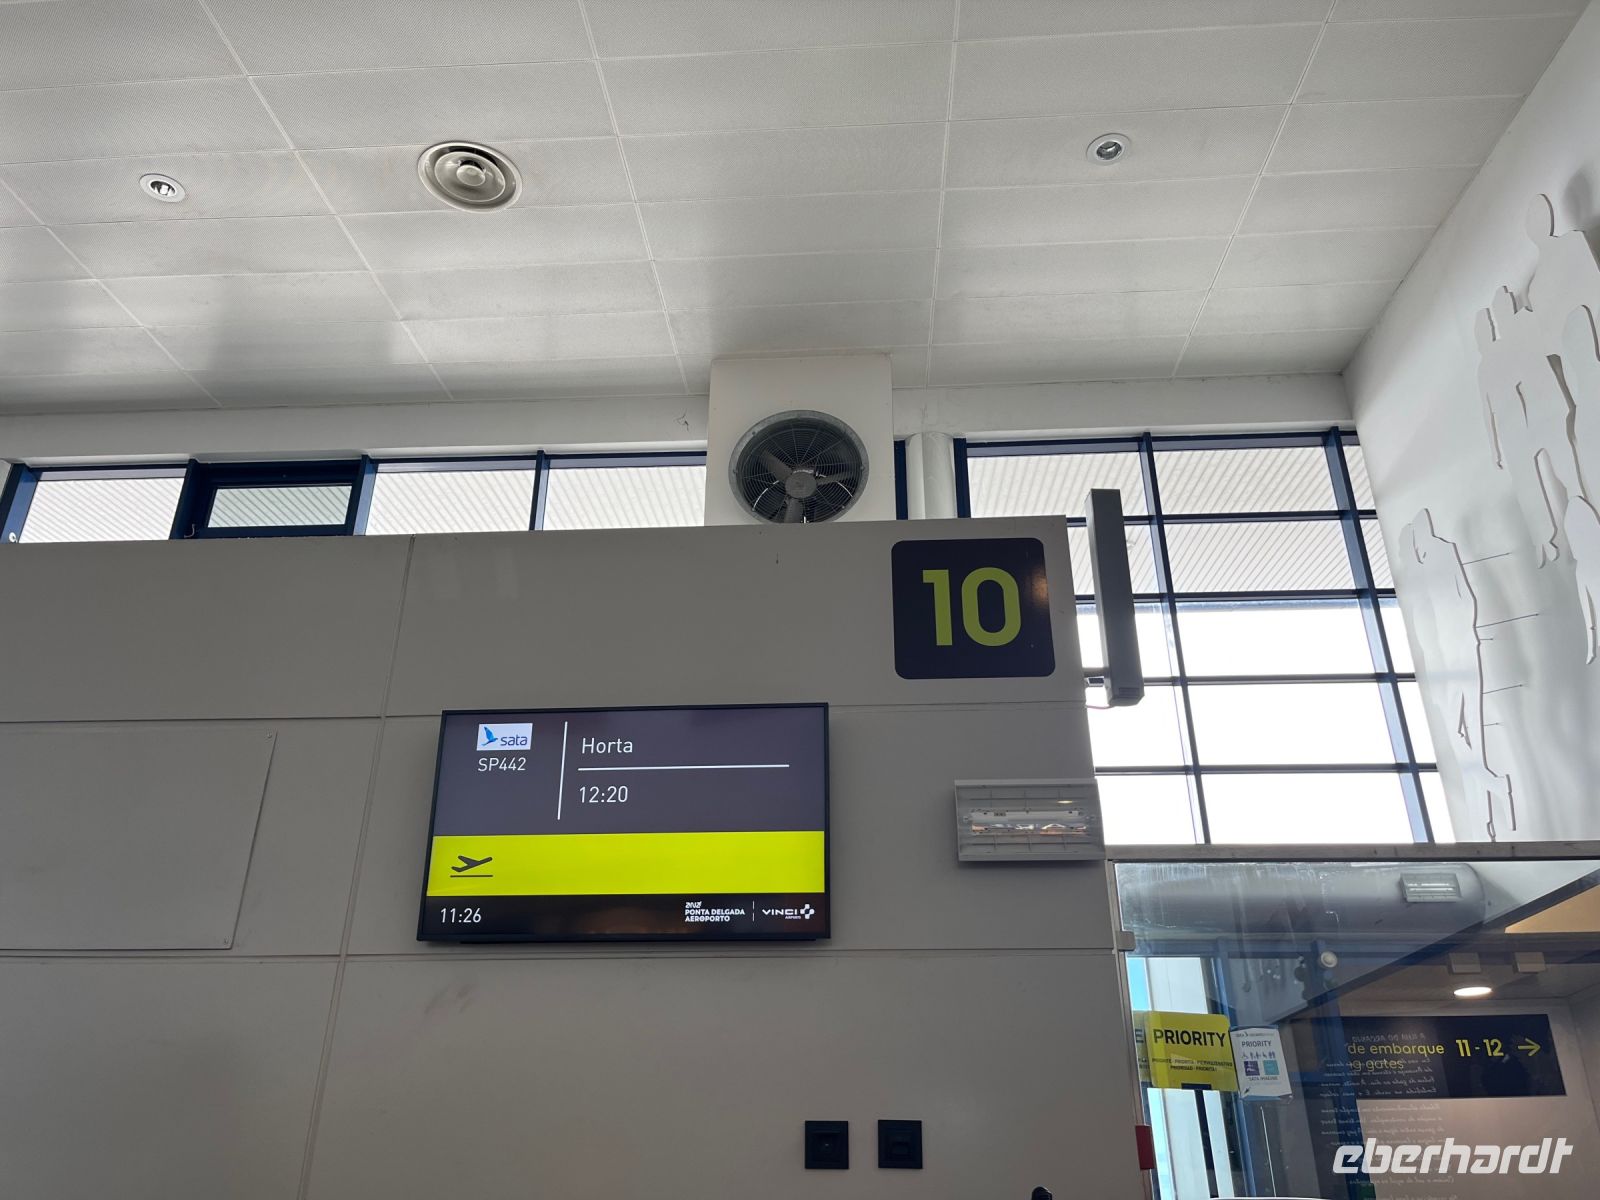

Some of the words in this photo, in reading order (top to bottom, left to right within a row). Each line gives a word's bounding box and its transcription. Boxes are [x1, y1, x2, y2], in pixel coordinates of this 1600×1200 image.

[921, 567, 1022, 647] 10
[500, 734, 528, 746] sata
[581, 737, 633, 754] Horta
[477, 757, 527, 772] SP442
[579, 785, 629, 804] 12:20
[440, 907, 482, 923] 11:26
[684, 908, 709, 916] PONTA
[711, 908, 746, 916] DELGADA
[1153, 1028, 1227, 1048] PRIORITY
[1241, 1039, 1272, 1048] PRIORITY
[1347, 1042, 1366, 1055] de
[1369, 1042, 1445, 1058] embarque
[1455, 1039, 1472, 1057] 11
[1483, 1038, 1504, 1057] 12
[1365, 1058, 1405, 1073] gates
